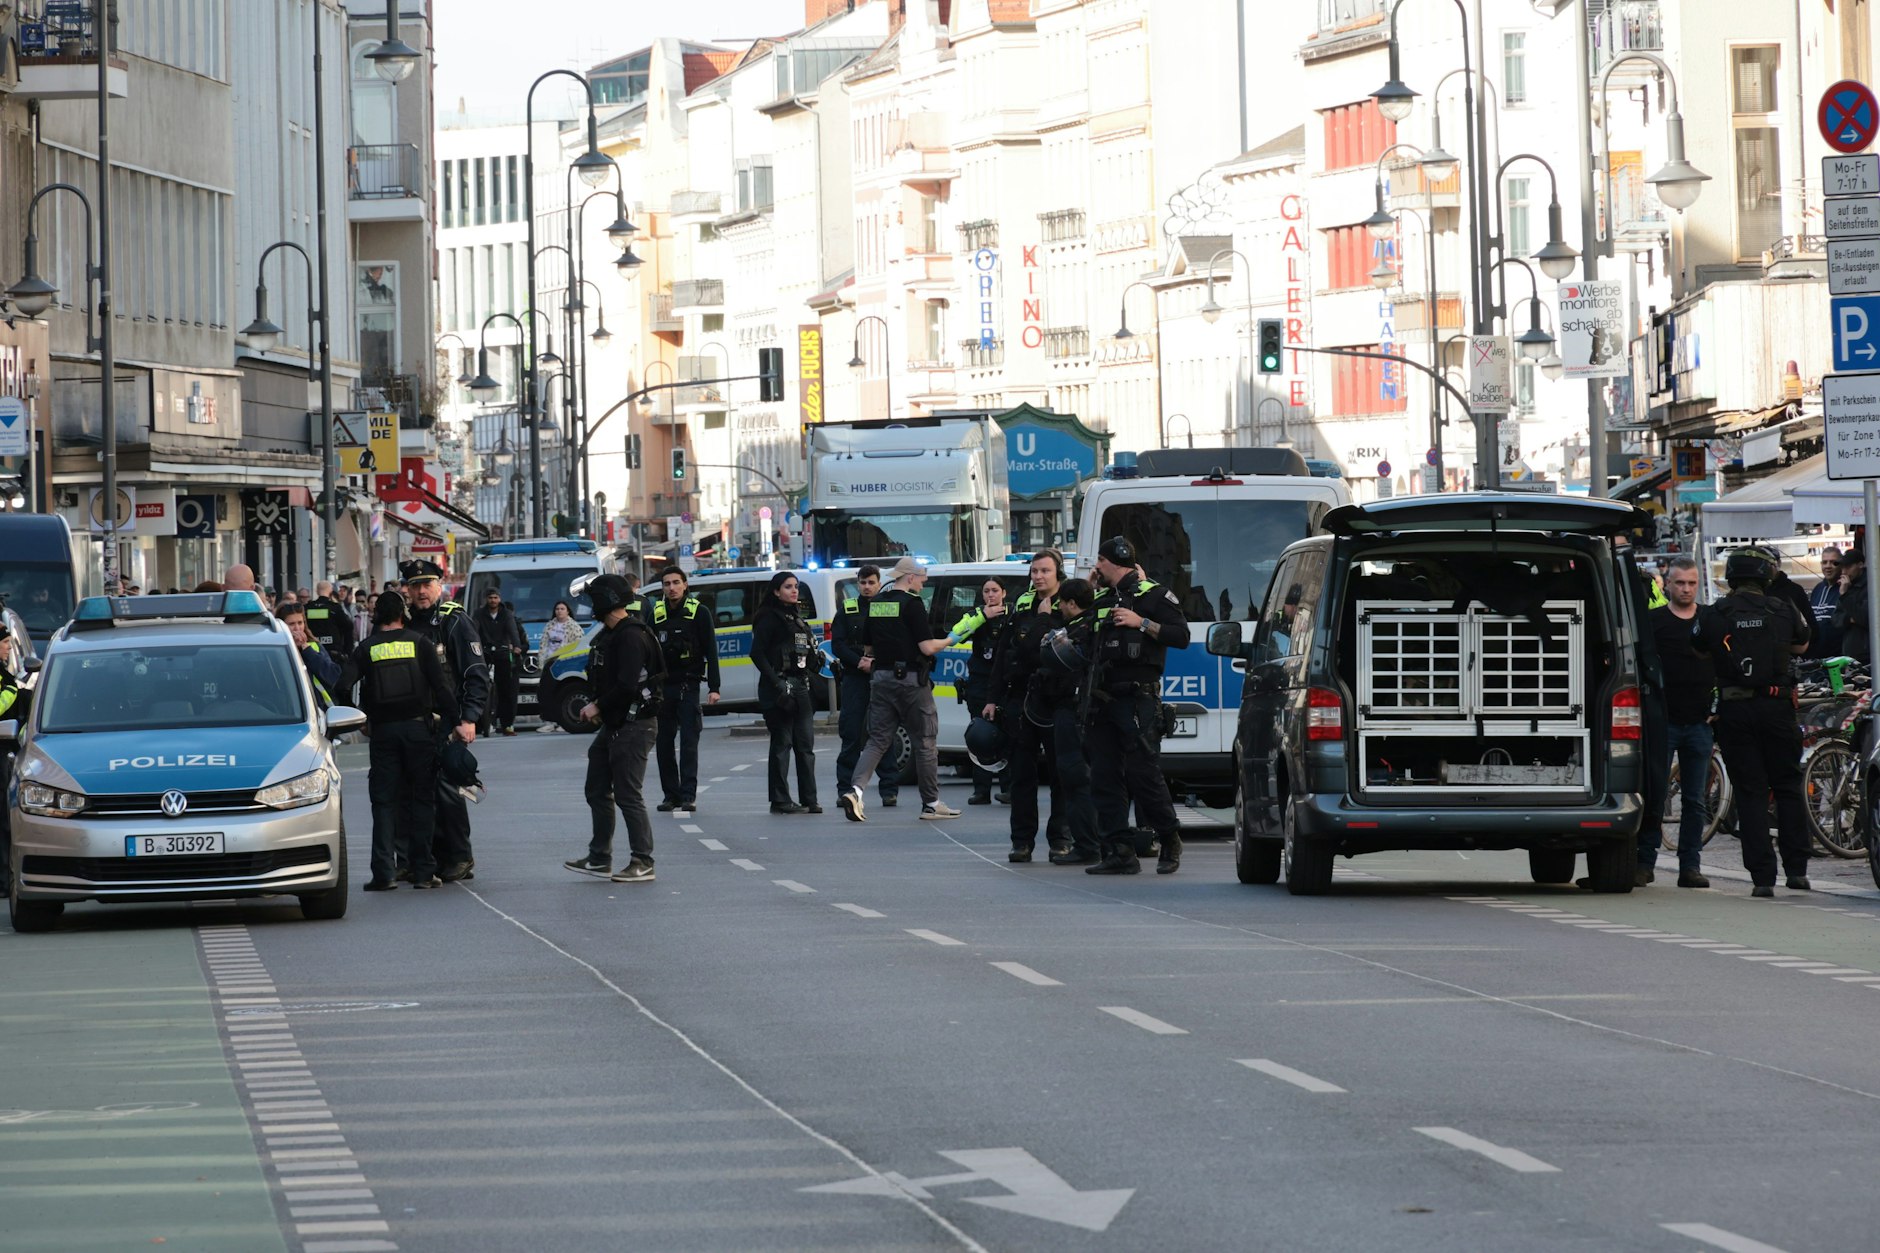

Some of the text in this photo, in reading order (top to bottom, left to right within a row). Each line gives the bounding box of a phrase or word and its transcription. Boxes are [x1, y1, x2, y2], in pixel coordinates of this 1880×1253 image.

[1835, 161, 1866, 174] Mo-Fr
[1837, 178, 1867, 190] 7-17 h
[1837, 204, 1868, 216] auf dem
[1828, 217, 1879, 231] Seitenstreifen
[1844, 276, 1867, 286] erlaubt
[1022, 244, 1043, 348] KINO
[1577, 283, 1621, 297] Werbe
[975, 247, 996, 351] OPER
[1280, 194, 1305, 406] GALERIE
[1560, 296, 1618, 311] monitore
[1606, 307, 1623, 319] ab
[1561, 317, 1617, 332] schalten
[1839, 306, 1869, 362] P
[1471, 336, 1496, 348] Kann
[1492, 348, 1506, 359] weg
[800, 329, 820, 423] der FUCHS
[1472, 392, 1504, 403] bleiben
[1830, 396, 1842, 406] mit
[1843, 394, 1877, 405] Parkschein
[371, 430, 391, 439] DE
[1838, 431, 1850, 442] für
[1854, 430, 1874, 441] Zone
[1017, 433, 1036, 456] U
[1357, 447, 1381, 457] RIX
[1838, 448, 1864, 459] Mo-Fr
[850, 481, 934, 493] HUBER LOGISTIK
[683, 545, 690, 555] P
[870, 602, 899, 616] POLIZEI
[1736, 619, 1762, 629] POLIZEI
[371, 641, 413, 658] POLIZEI
[717, 639, 741, 654] IZEI
[1160, 675, 1206, 697] IZEI
[109, 754, 236, 771] POLIZEI
[144, 838, 155, 853] B
[166, 835, 215, 852] 30392
